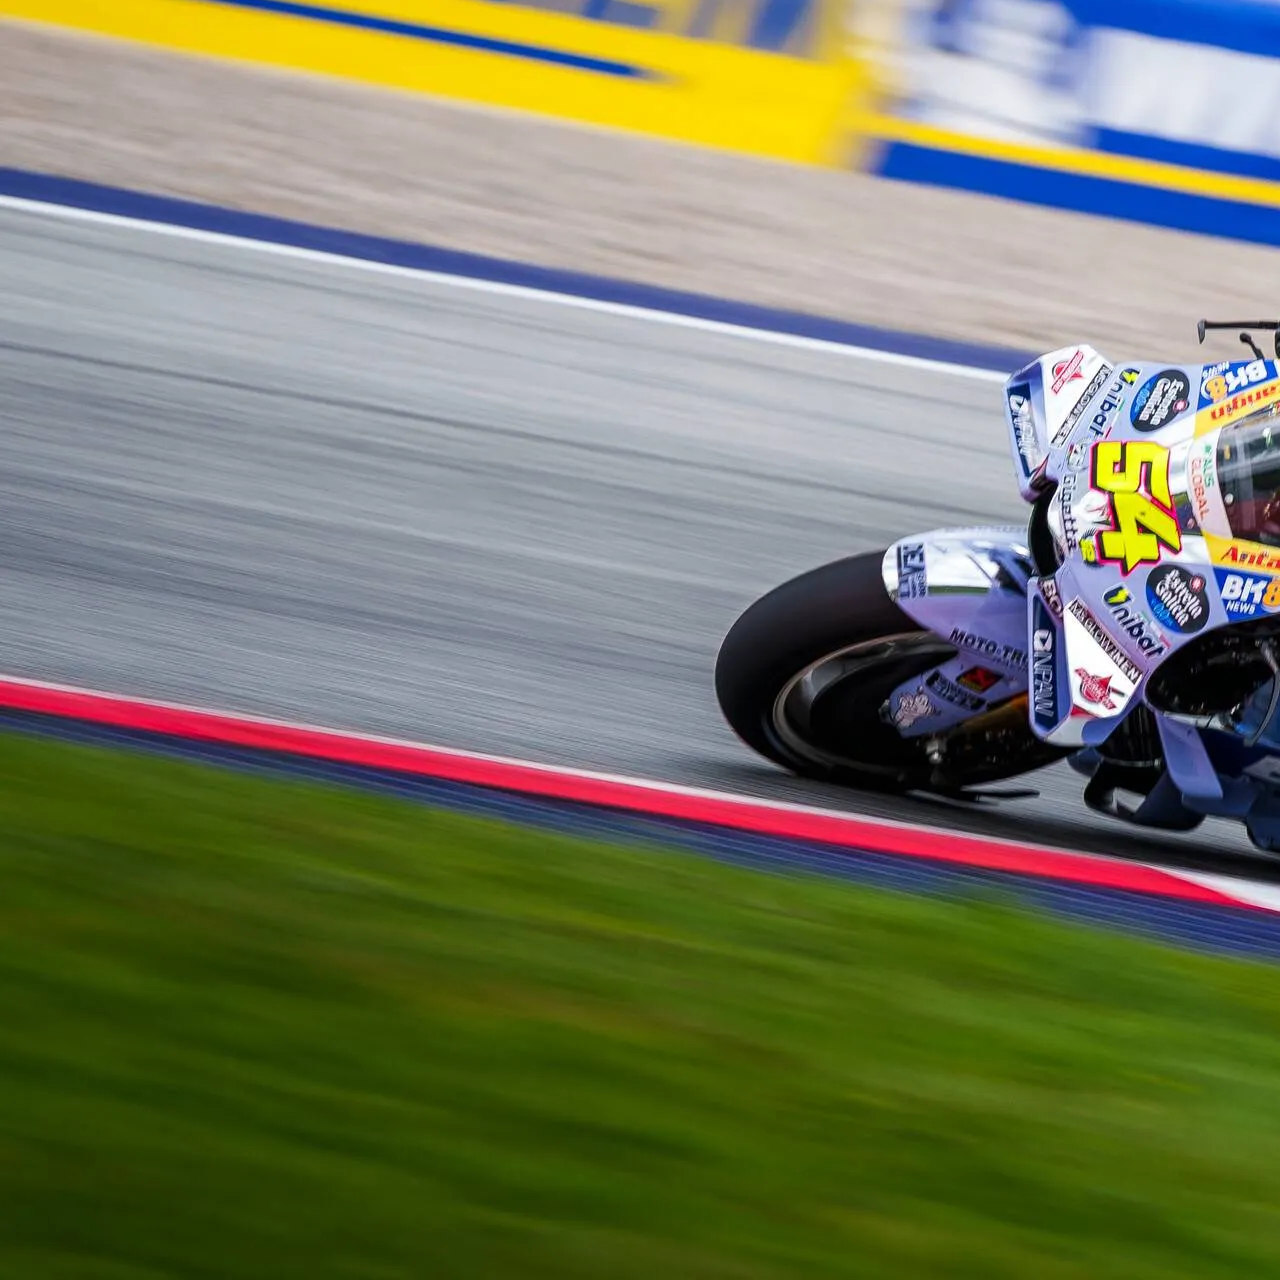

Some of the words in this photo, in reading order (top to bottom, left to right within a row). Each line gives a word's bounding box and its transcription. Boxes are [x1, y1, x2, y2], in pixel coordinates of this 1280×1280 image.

[1089, 368, 1141, 439] Unibat
[1091, 441, 1181, 575] 54
[1103, 586, 1165, 658] Unibat
[1226, 601, 1256, 614] NEWS
